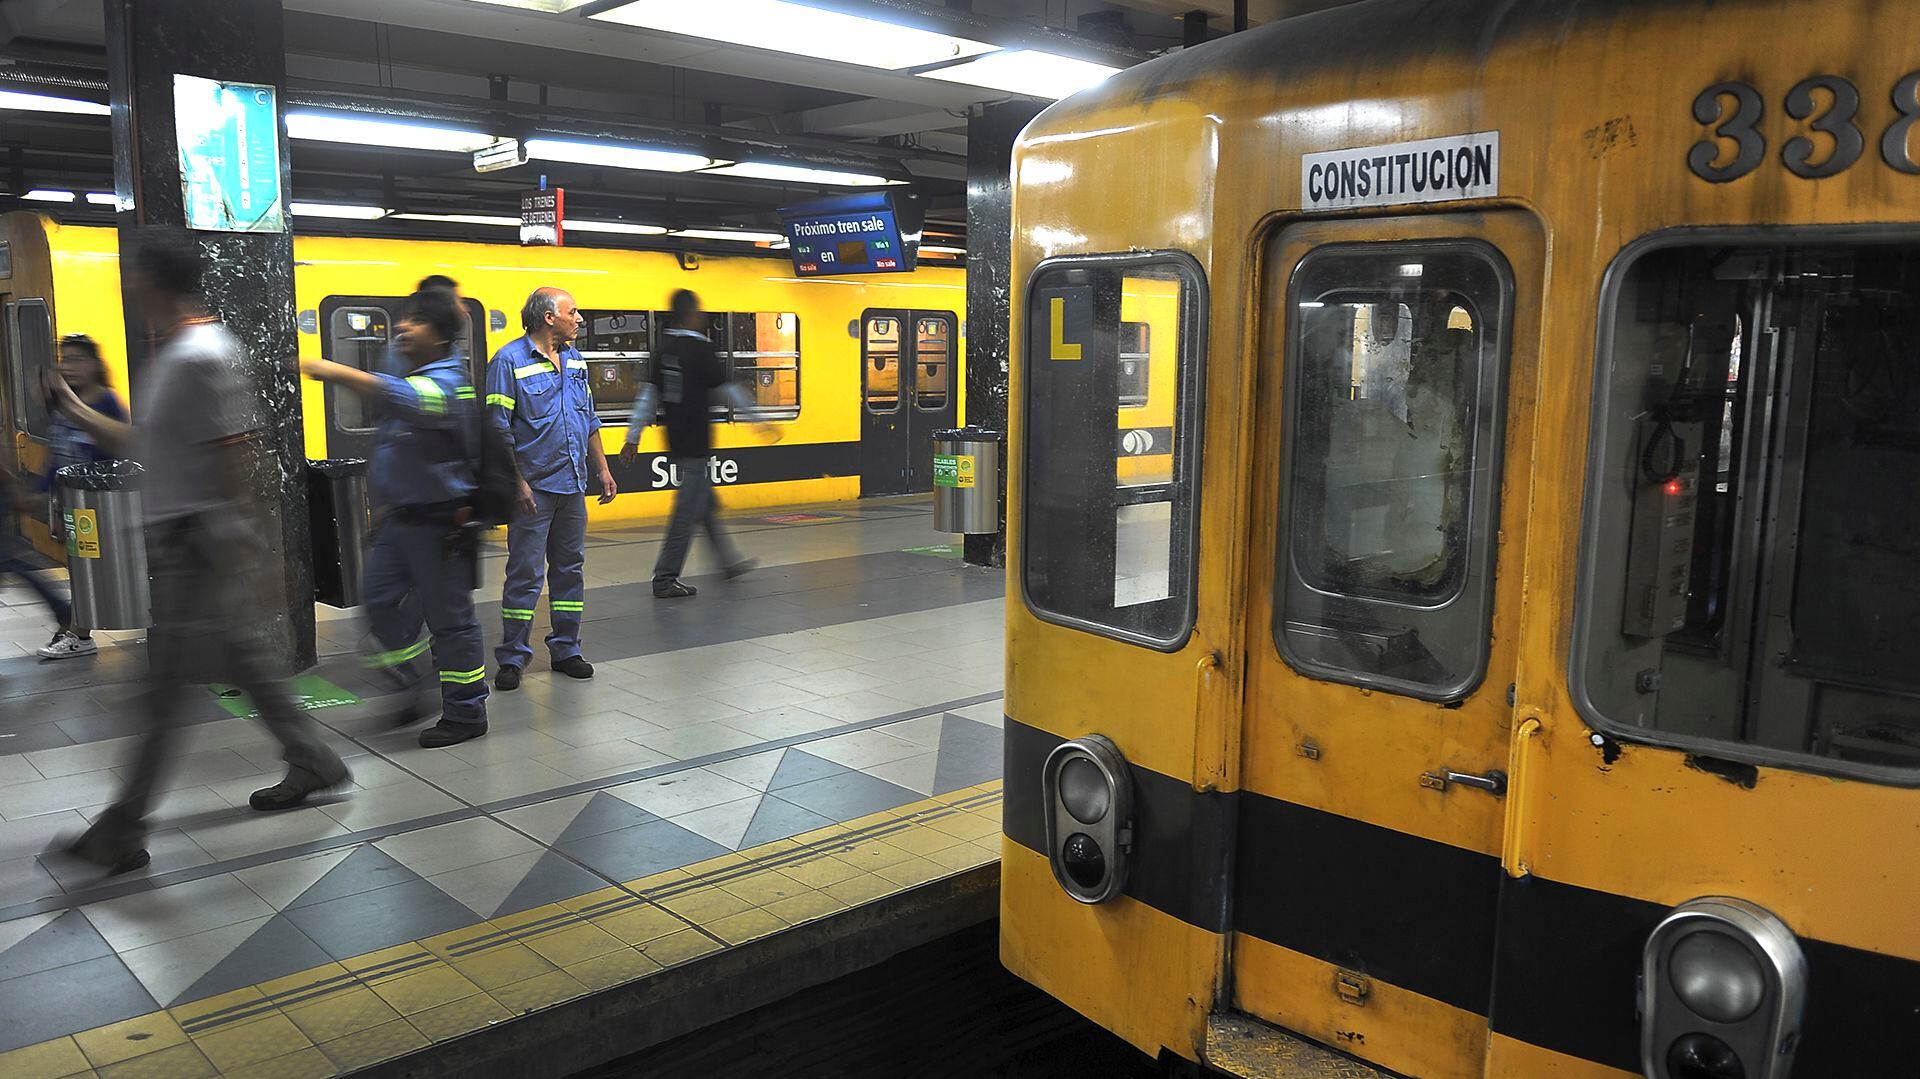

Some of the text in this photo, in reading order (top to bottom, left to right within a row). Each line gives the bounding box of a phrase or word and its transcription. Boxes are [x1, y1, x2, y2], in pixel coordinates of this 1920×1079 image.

[1308, 144, 1492, 202] CONSTITUCION
[521, 195, 555, 209] LOS TRENES
[521, 211, 556, 223] SE DETIENEN
[794, 215, 885, 236] Próximo tren sale
[820, 251, 835, 262] en
[885, 259, 896, 267] sale
[1050, 297, 1082, 361] L
[651, 455, 739, 489] Sute
